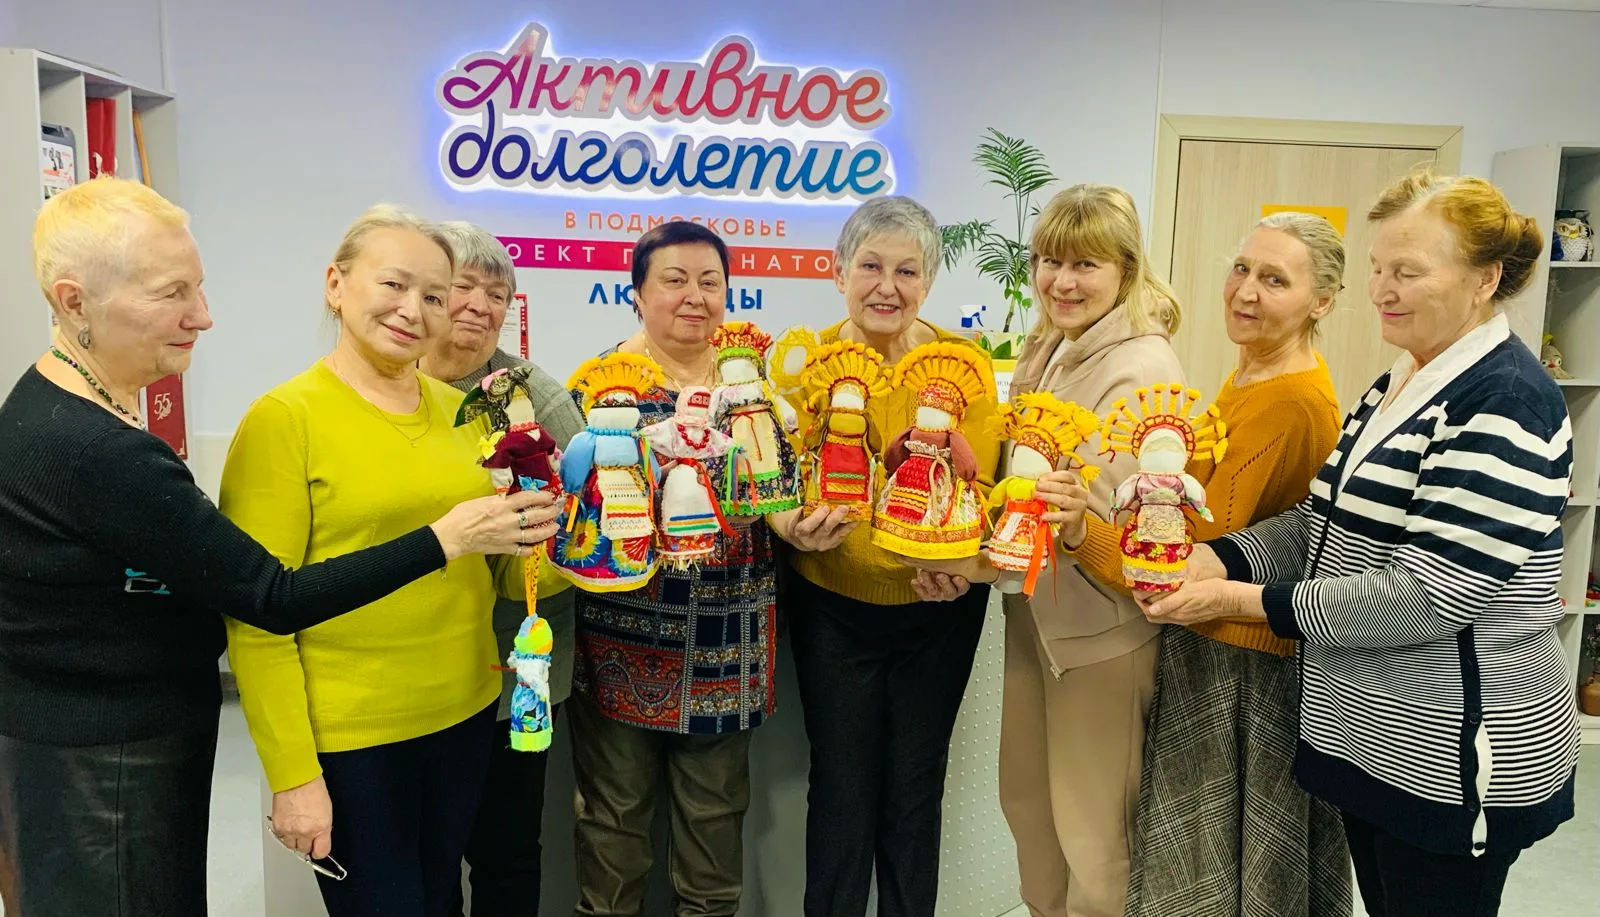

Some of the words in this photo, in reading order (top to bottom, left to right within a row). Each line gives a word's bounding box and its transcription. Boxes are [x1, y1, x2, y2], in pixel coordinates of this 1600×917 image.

[443, 30, 885, 124] Активное
[449, 99, 885, 195] долголетие
[564, 212, 576, 229] В
[506, 243, 596, 263] ОЕКТ
